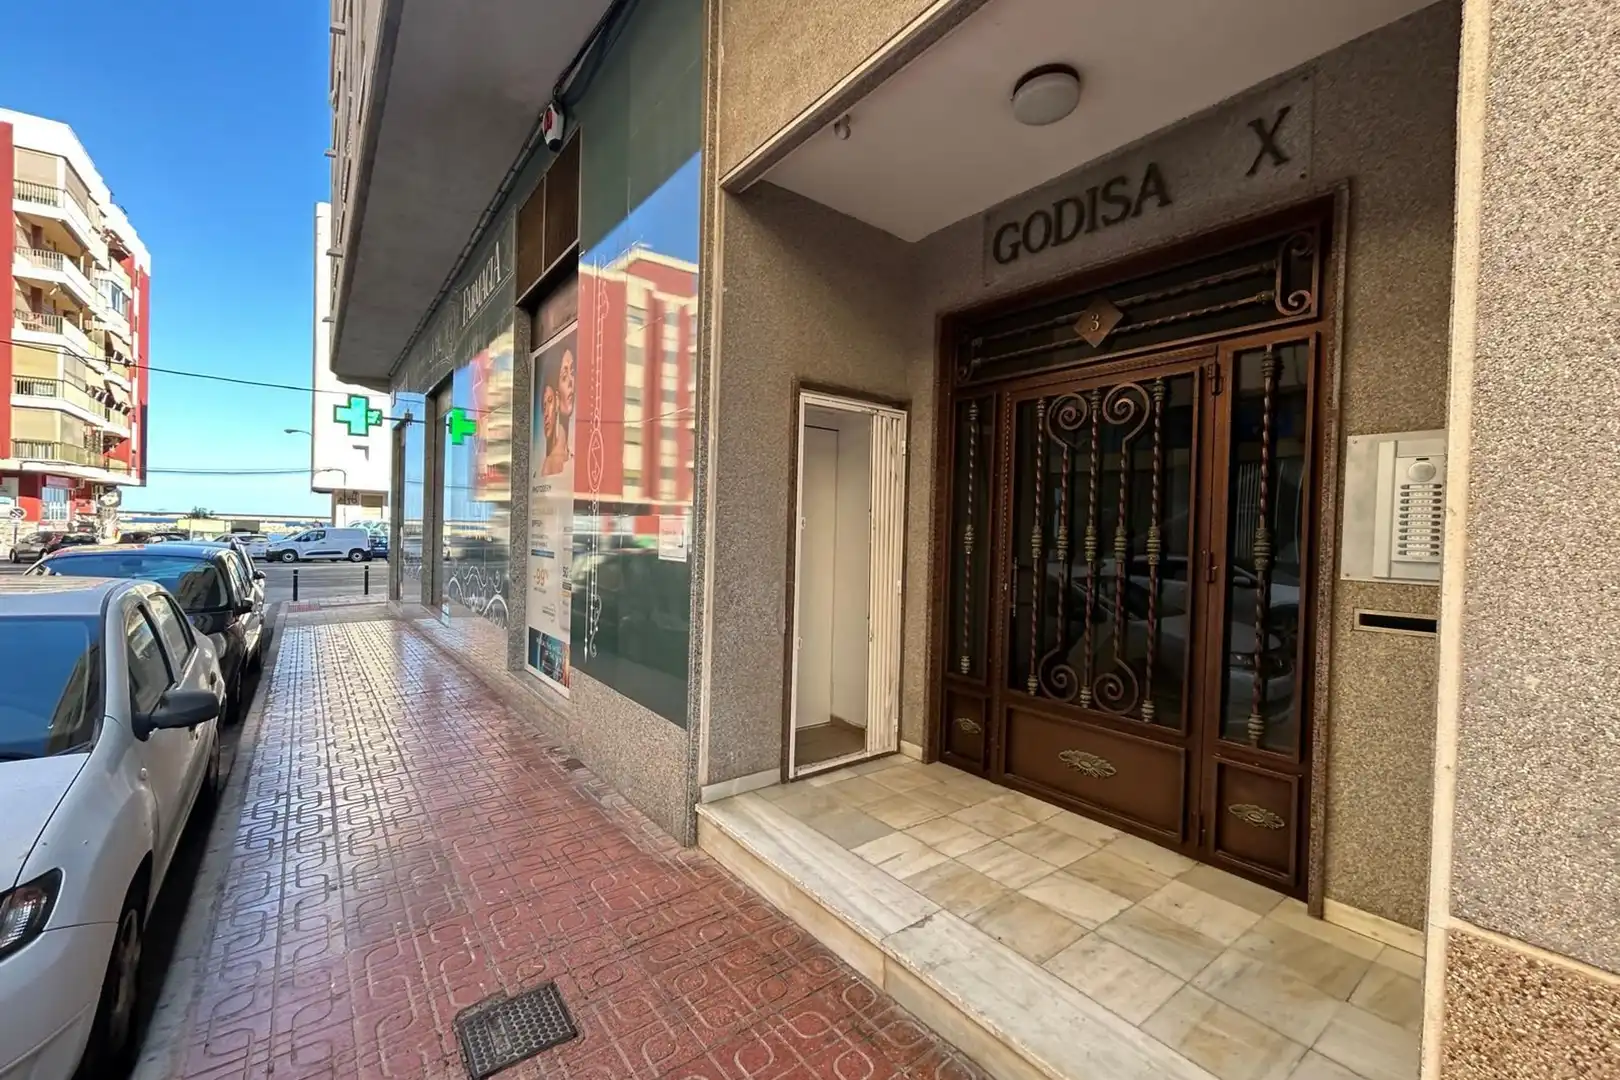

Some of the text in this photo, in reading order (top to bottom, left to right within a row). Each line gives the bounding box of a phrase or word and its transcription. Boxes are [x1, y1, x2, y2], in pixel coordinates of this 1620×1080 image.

[992, 105, 1291, 265] GODISA X
[462, 241, 501, 328] FARMACIA
[1090, 312, 1100, 332] 3
